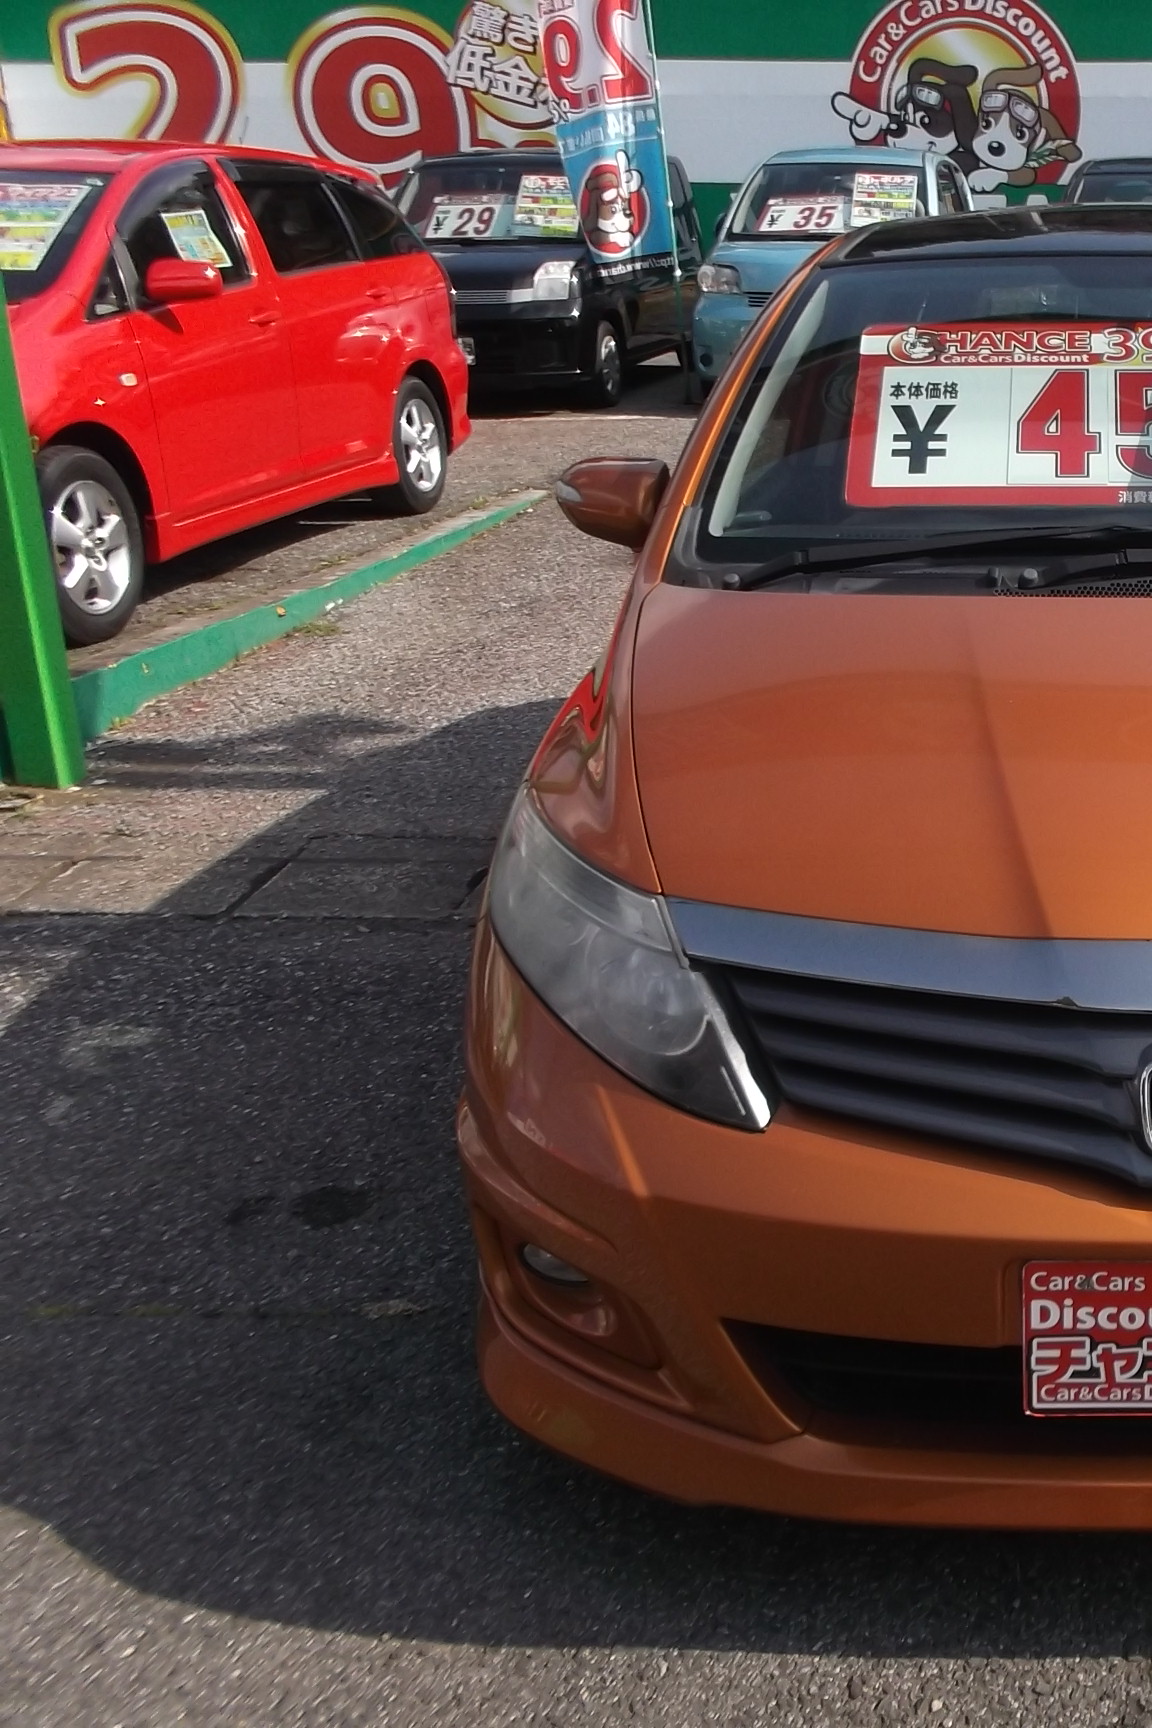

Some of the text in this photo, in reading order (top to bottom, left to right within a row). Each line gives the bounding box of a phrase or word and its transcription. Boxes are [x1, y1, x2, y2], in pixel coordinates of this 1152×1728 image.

[467, 2, 539, 55] 驚き
[442, 38, 551, 109] 低金
[452, 206, 496, 236] 29
[793, 205, 838, 229] 35
[889, 381, 960, 400] 本体価格
[890, 404, 957, 475] ¥
[1029, 1271, 1147, 1293] Car&Cars
